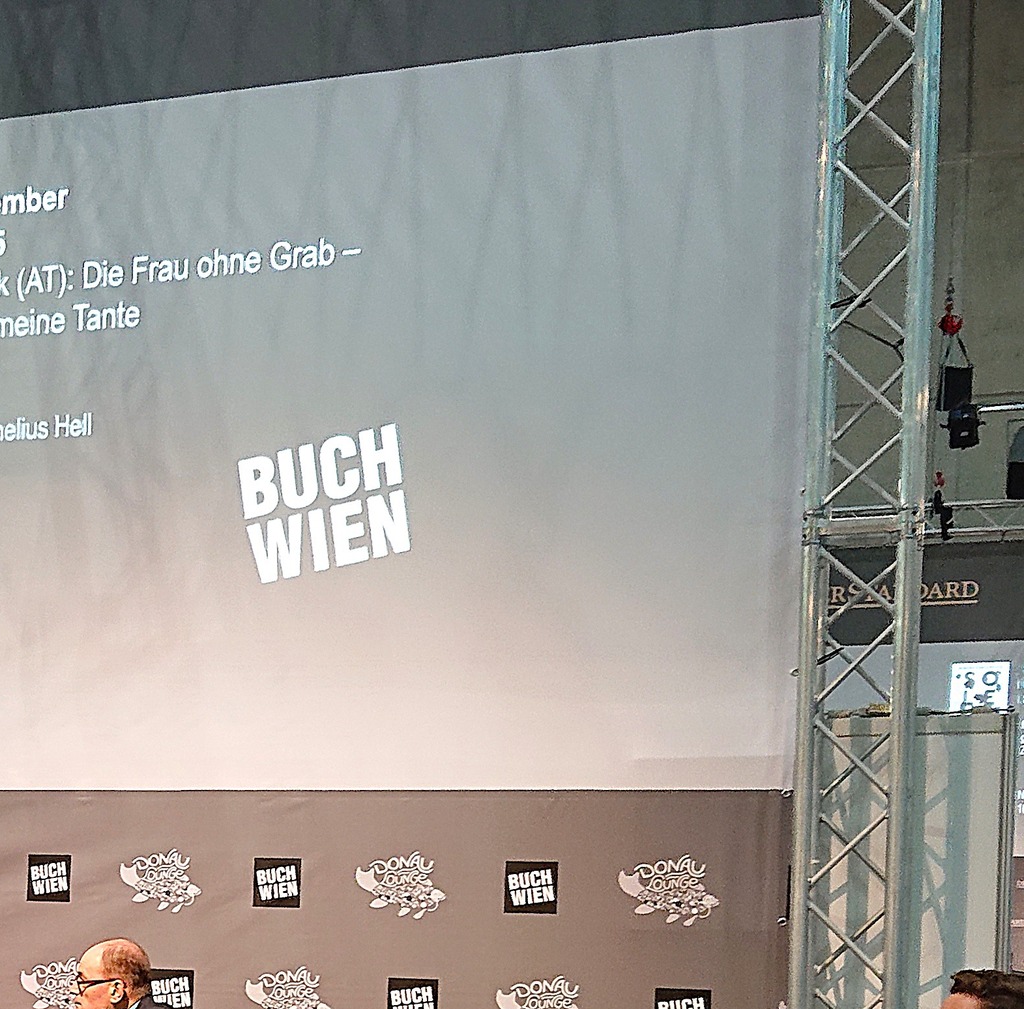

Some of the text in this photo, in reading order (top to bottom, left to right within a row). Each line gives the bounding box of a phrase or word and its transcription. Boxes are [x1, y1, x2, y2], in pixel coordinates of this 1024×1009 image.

[16, 263, 74, 302] (AT):
[82, 259, 124, 289] Die
[131, 254, 189, 284] Frau
[196, 248, 262, 279] ohne
[269, 237, 336, 271] Grab
[72, 300, 141, 332] Tante
[54, 412, 93, 438] Hell
[236, 423, 404, 520] BUCH
[245, 489, 412, 585] WIEN
[133, 848, 190, 870] DONAU
[369, 851, 434, 875] DONAU
[634, 854, 706, 878] DONAU
[30, 860, 67, 881] BUCH
[256, 865, 297, 885] BUCH
[507, 868, 553, 890] BUCH
[31, 876, 68, 896] WIEN
[258, 881, 299, 901] WIEN
[510, 885, 555, 907] WIEN
[33, 957, 79, 979] DONA
[259, 966, 319, 989] DONAU
[151, 977, 189, 997] BUCH
[390, 985, 433, 1006] BUCH
[510, 975, 579, 999] DONAU
